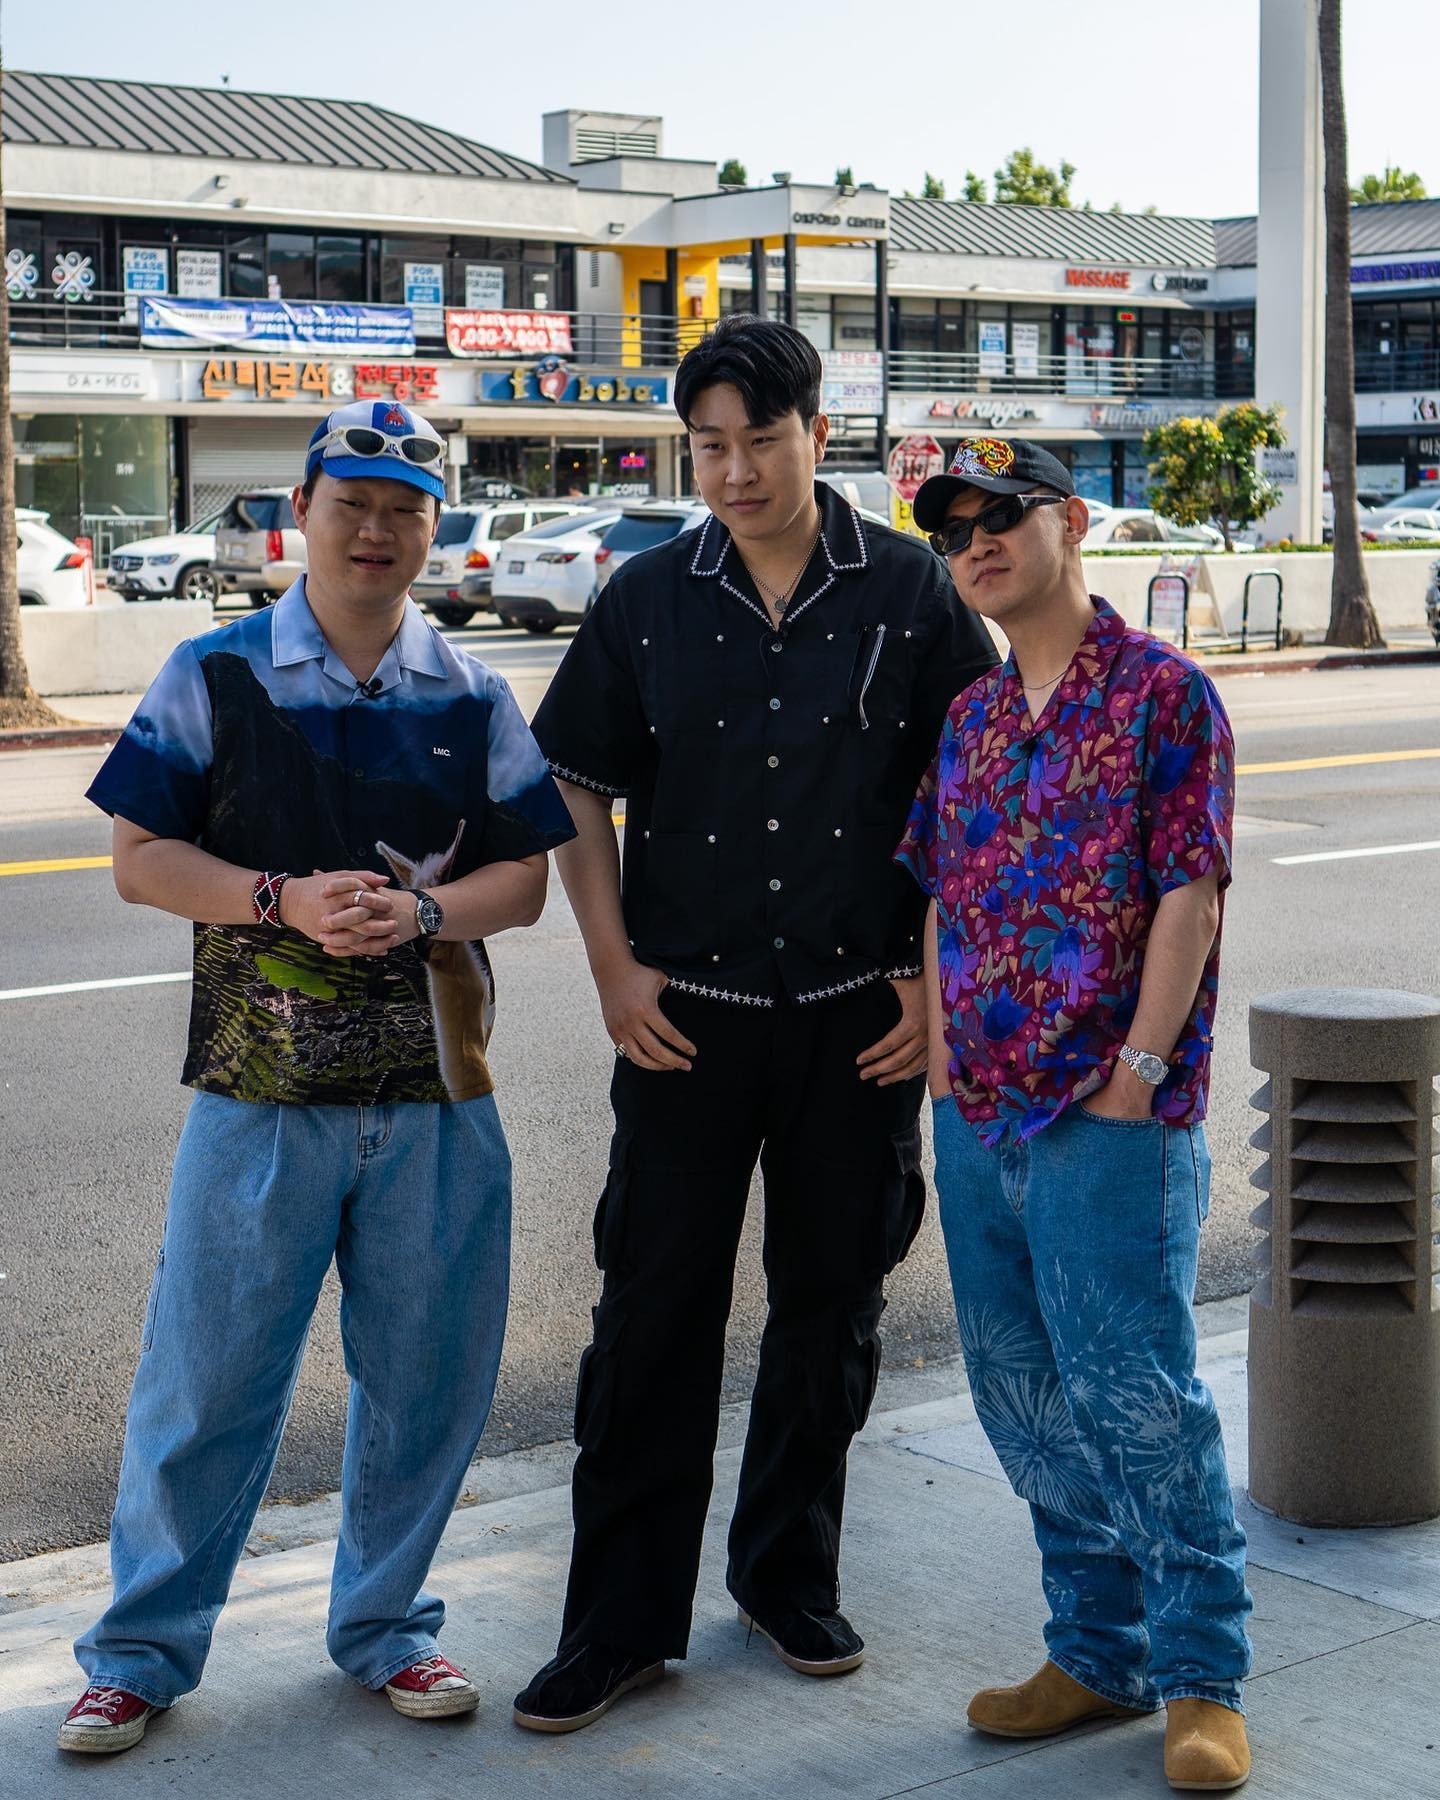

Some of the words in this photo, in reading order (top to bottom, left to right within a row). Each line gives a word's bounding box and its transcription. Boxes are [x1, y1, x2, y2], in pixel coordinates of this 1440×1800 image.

[846, 216, 886, 229] CENTER
[133, 251, 158, 261] FOR
[127, 261, 163, 271] LEASE
[412, 266, 434, 275] FOR
[407, 275, 440, 285] LEASE
[1065, 269, 1131, 289] MASSAGE
[614, 483, 650, 496] COFFEE
